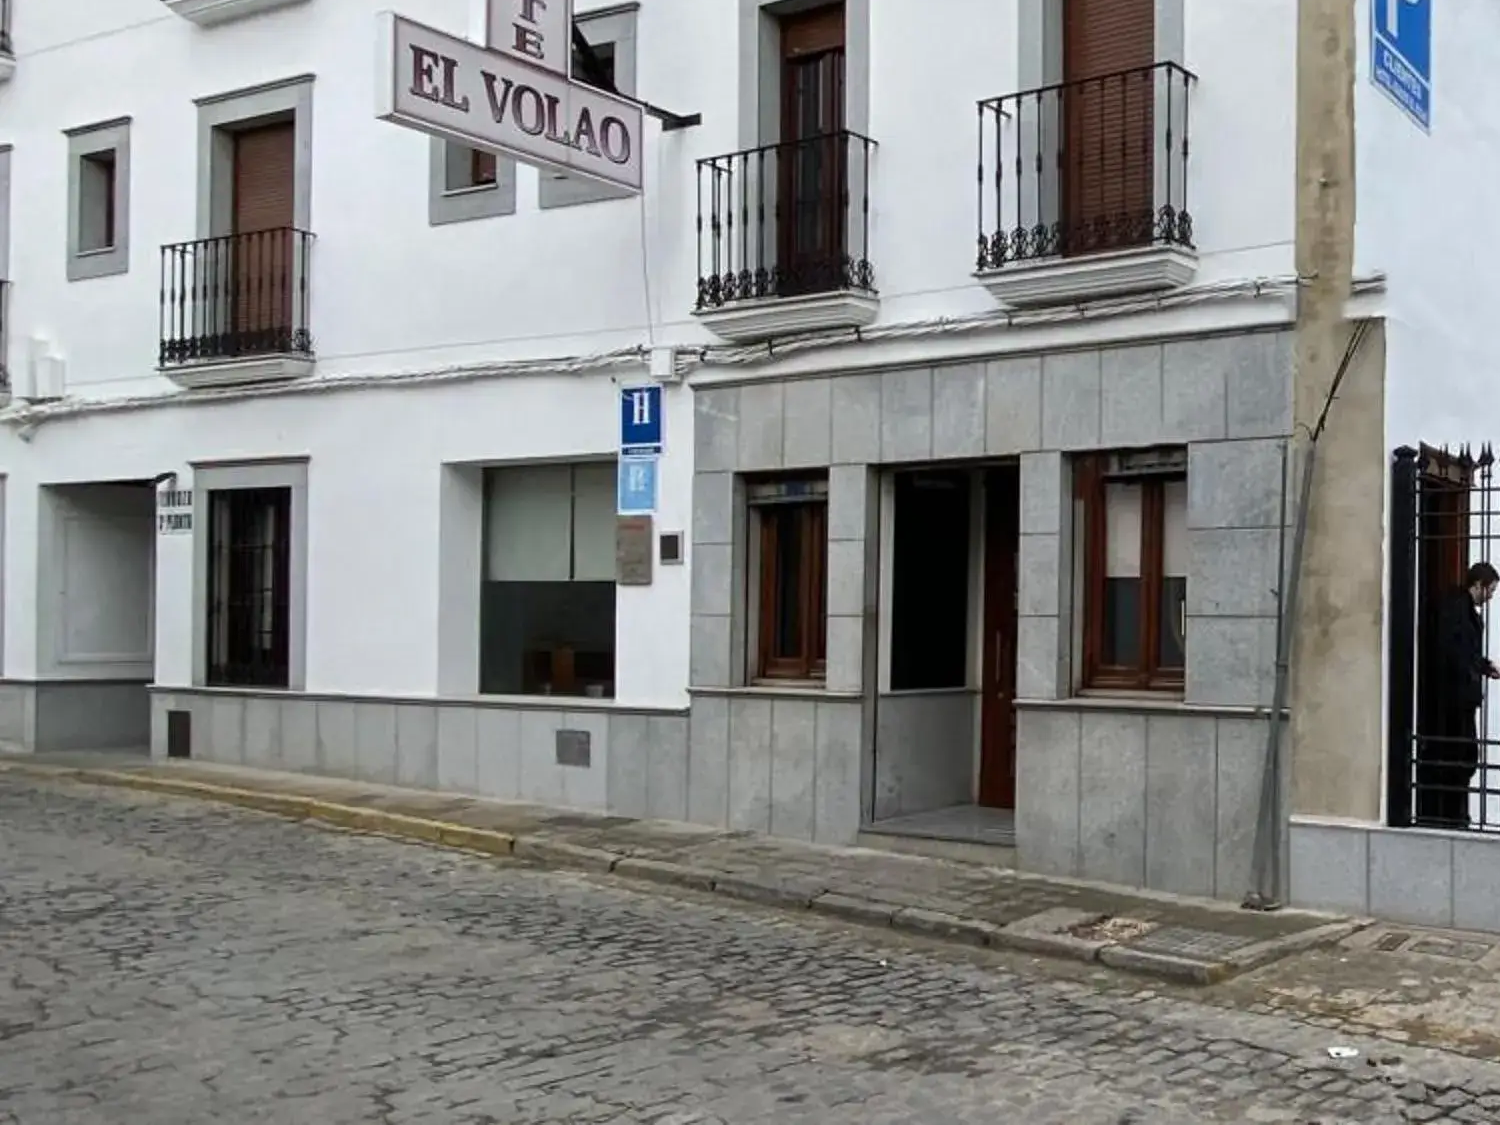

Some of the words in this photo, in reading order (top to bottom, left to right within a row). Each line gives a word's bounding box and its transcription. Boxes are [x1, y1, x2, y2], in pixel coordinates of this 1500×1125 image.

[408, 42, 469, 113] EL
[480, 68, 632, 165] VOLAO
[632, 391, 650, 425] H
